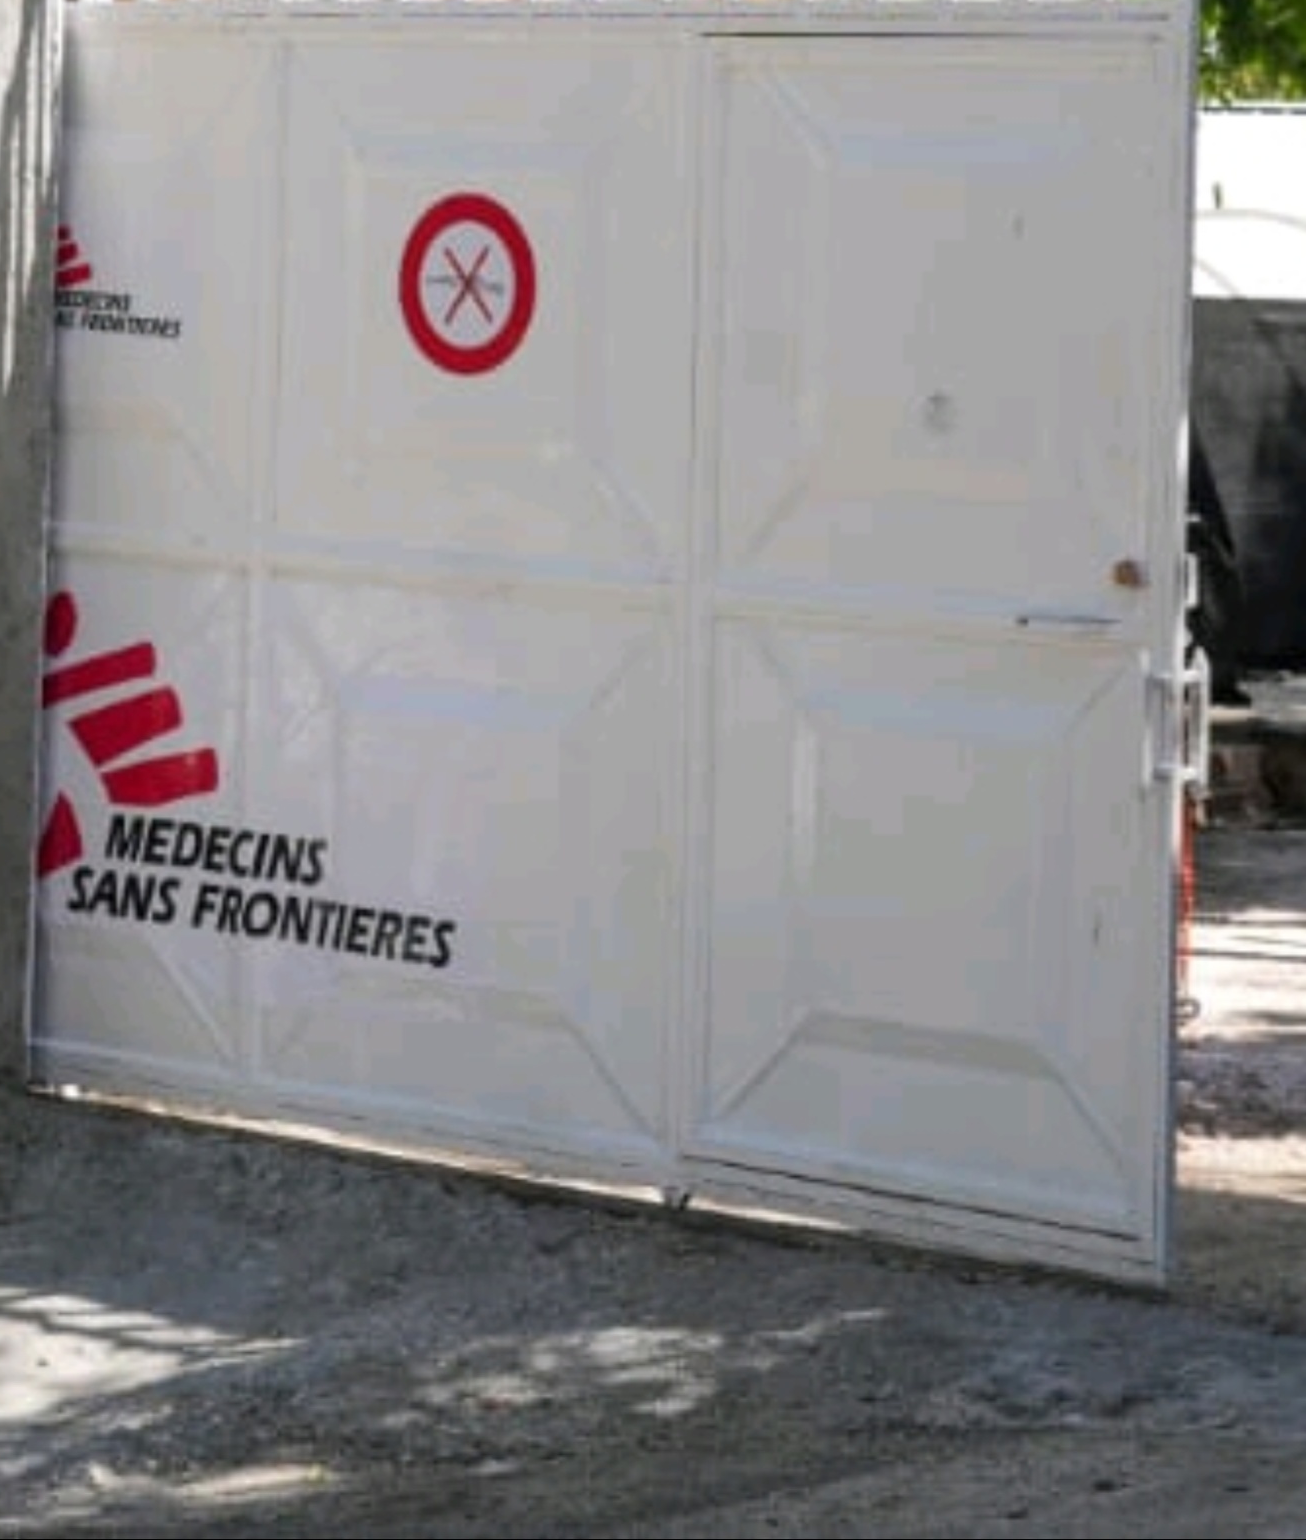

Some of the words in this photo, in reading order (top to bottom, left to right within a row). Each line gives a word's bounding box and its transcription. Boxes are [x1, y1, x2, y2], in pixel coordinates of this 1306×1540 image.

[105, 813, 327, 886] MEDECINS
[67, 866, 179, 924] SANS
[192, 882, 456, 969] FRONTIERES
